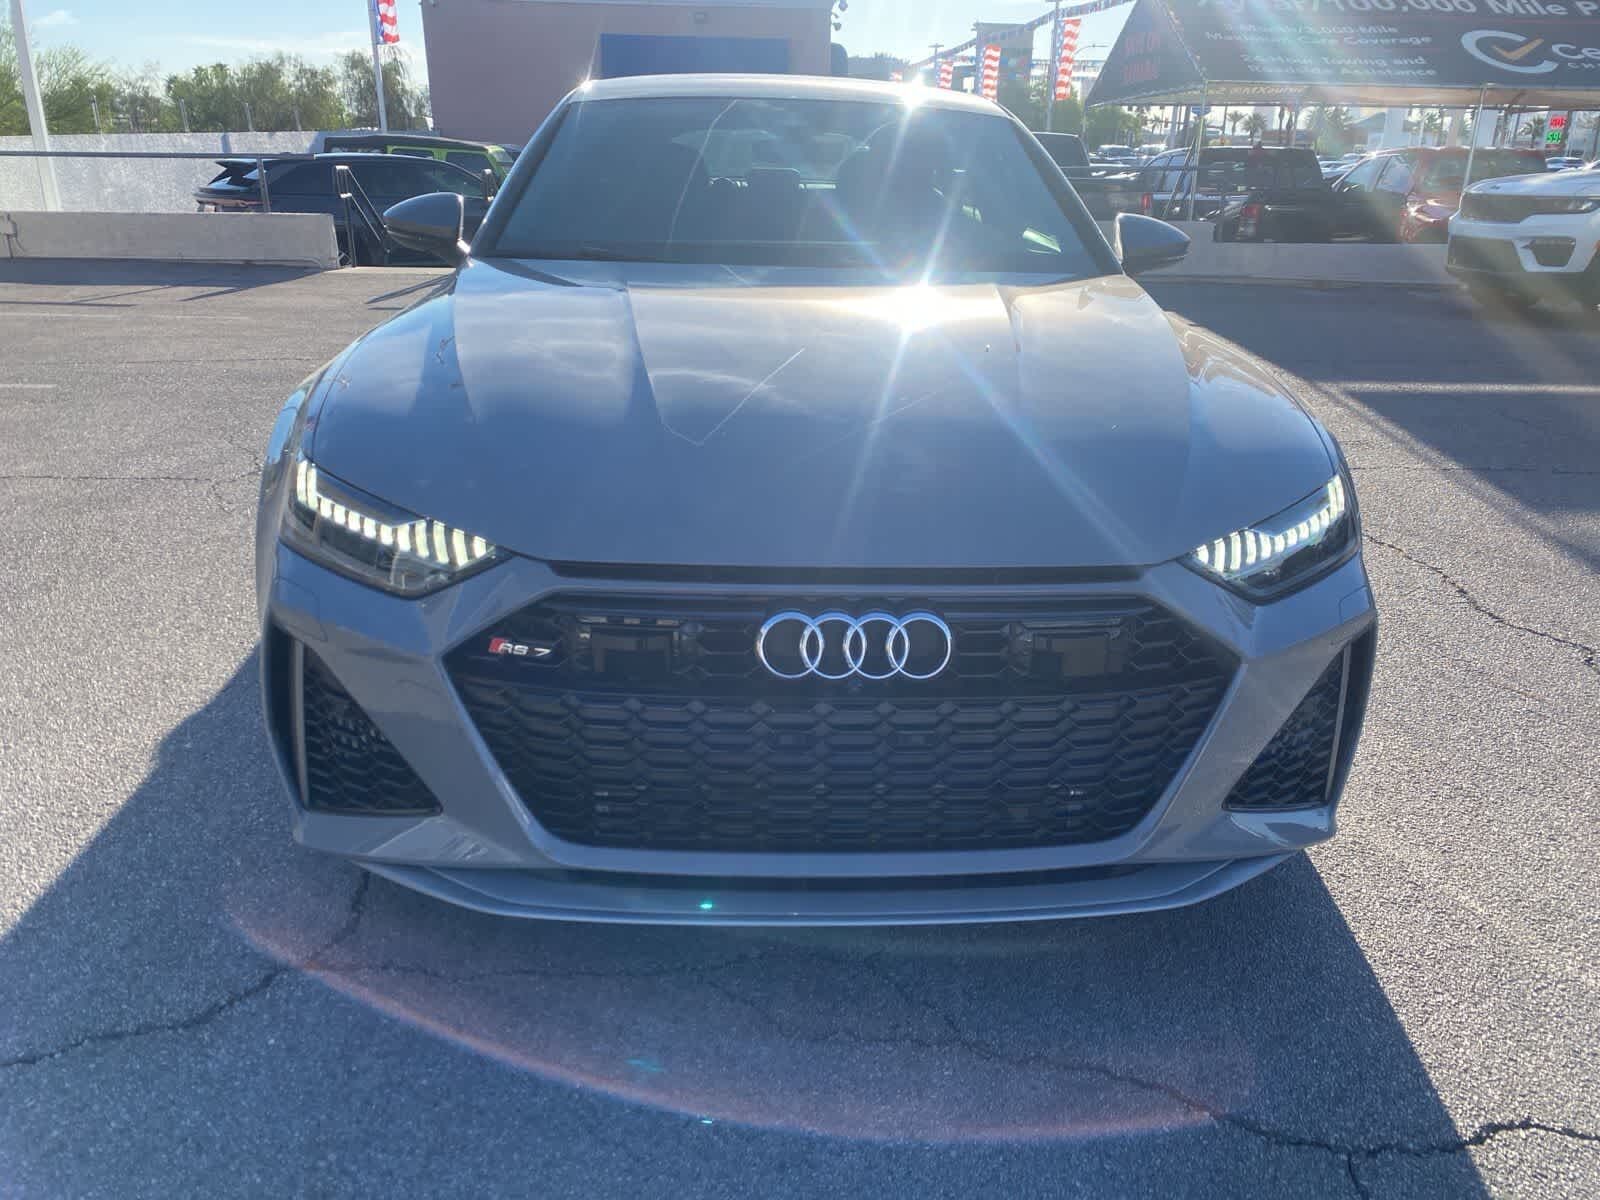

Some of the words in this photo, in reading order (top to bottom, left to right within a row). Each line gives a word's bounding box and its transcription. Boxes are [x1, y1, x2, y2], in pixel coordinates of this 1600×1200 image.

[1485, 0, 1569, 15] Mile
[1344, 36, 1432, 46] Coverage
[1393, 56, 1427, 65] and
